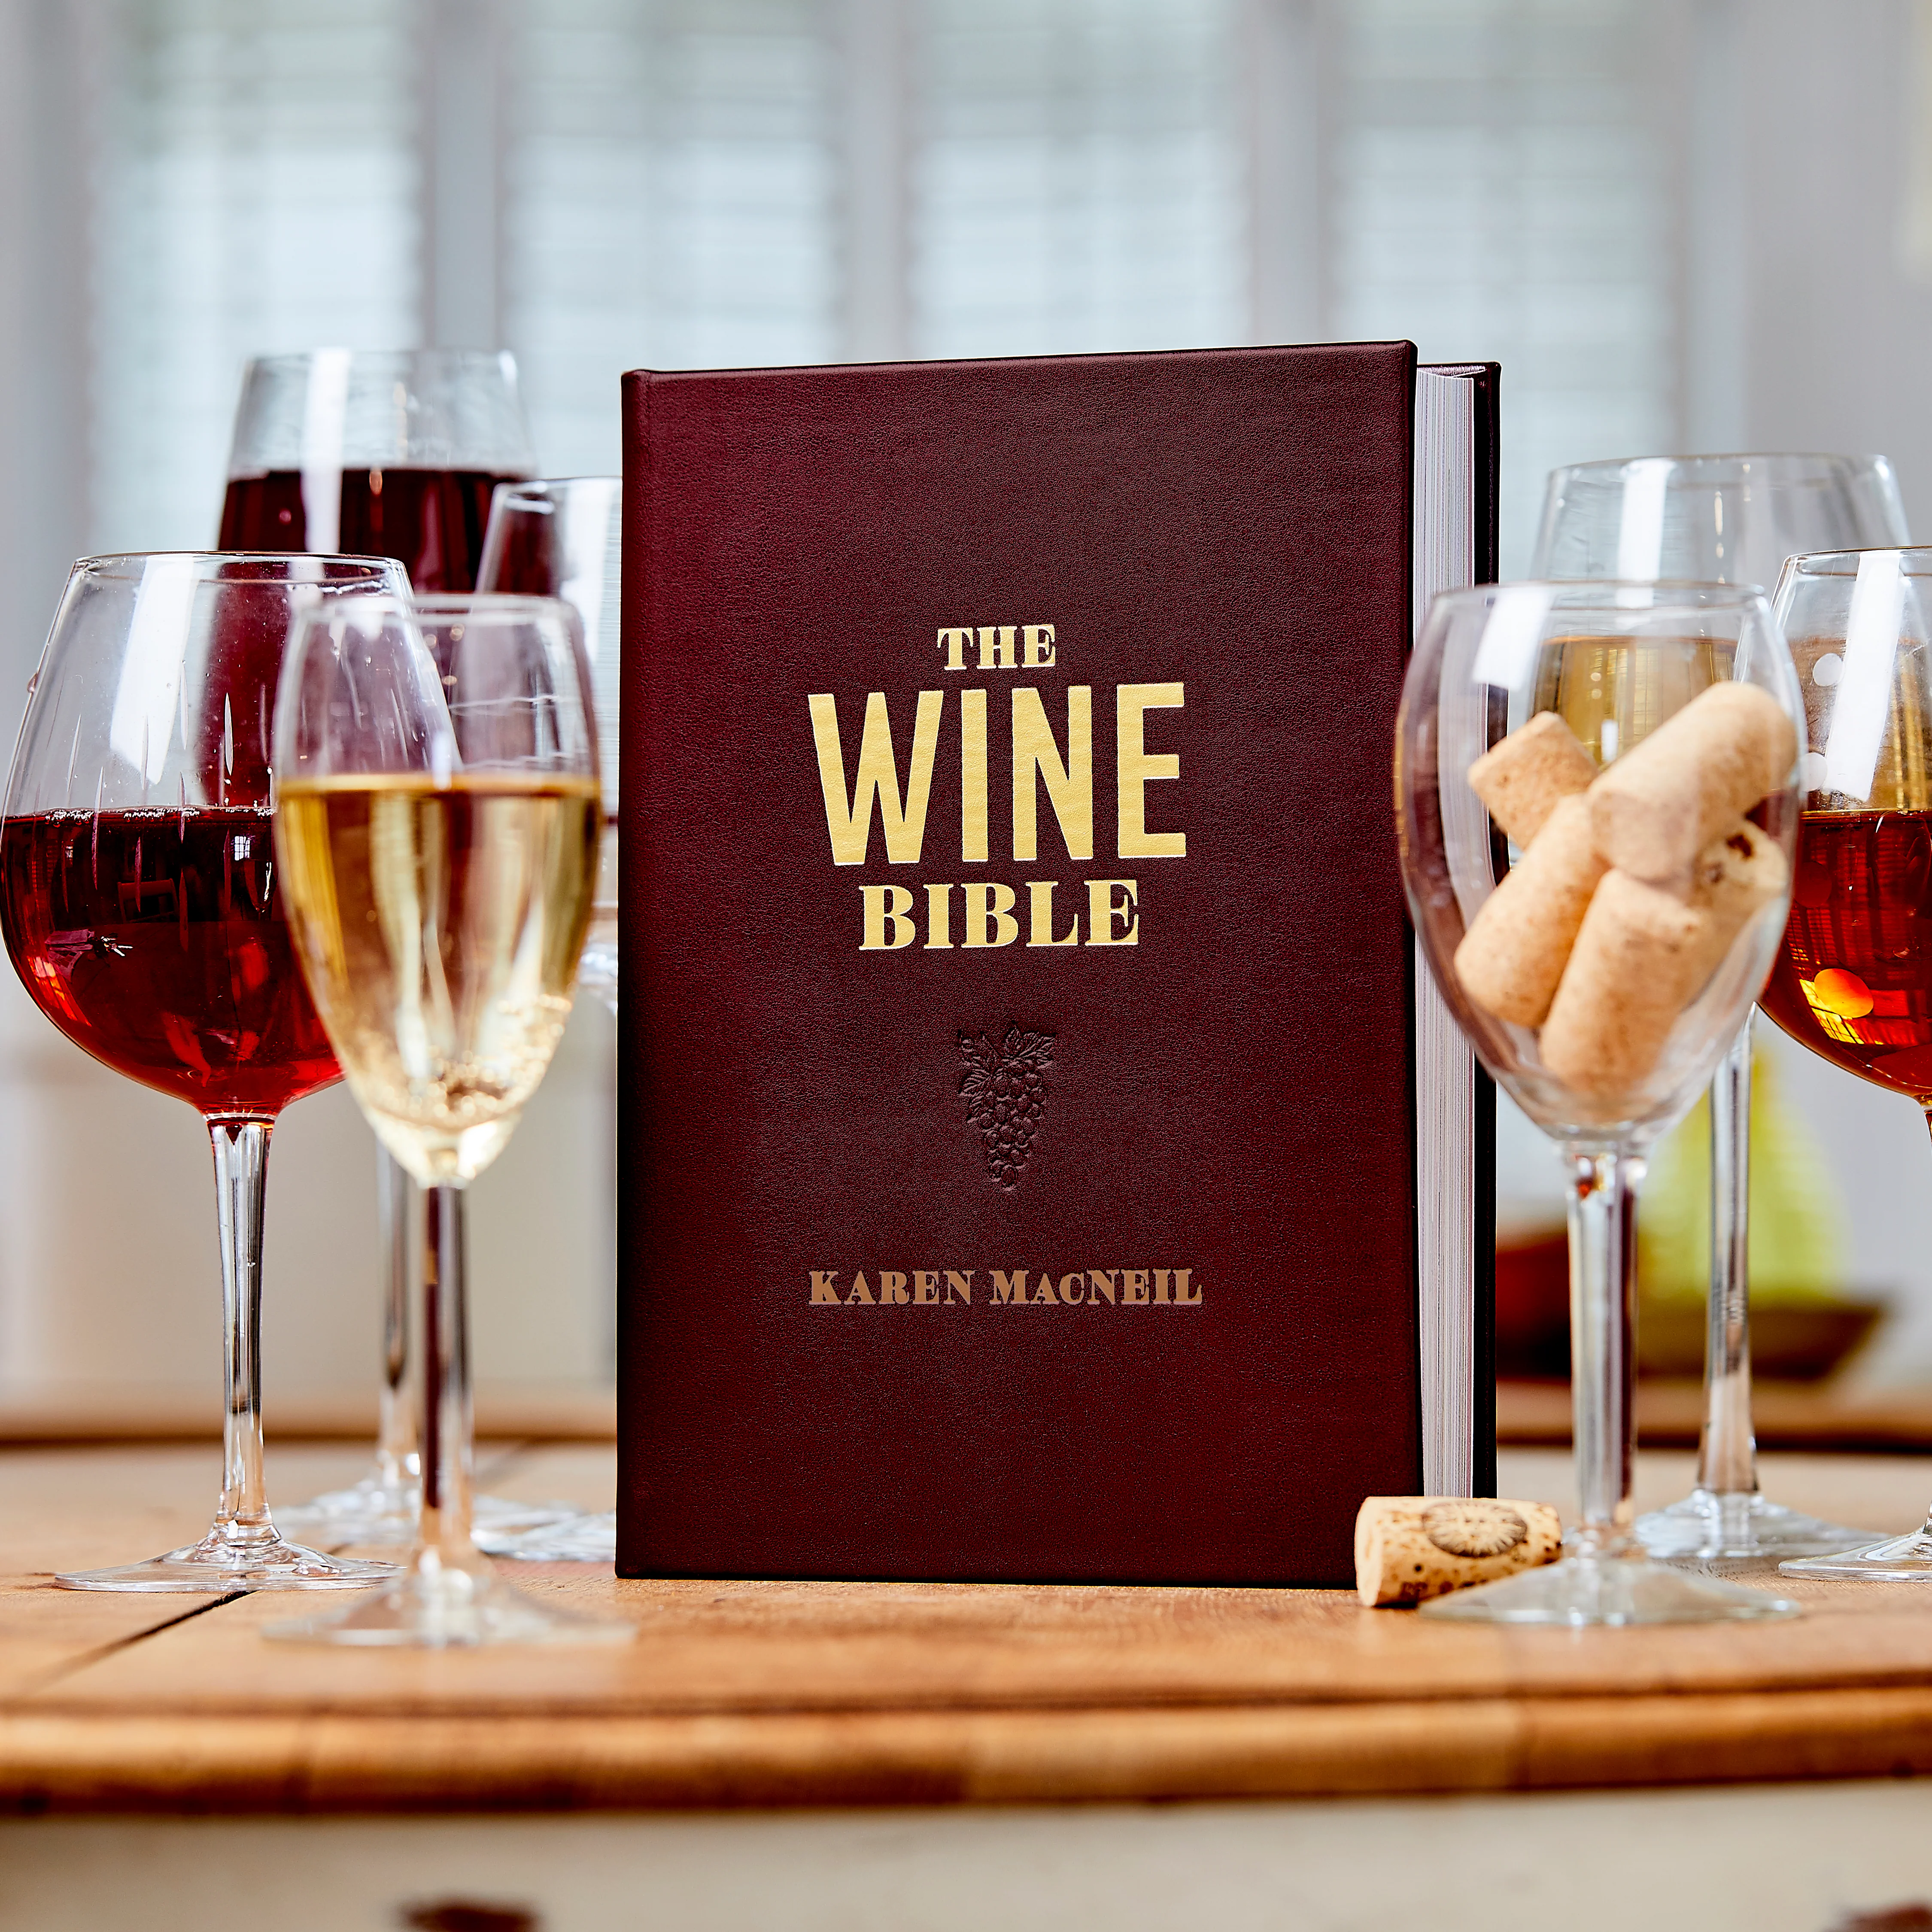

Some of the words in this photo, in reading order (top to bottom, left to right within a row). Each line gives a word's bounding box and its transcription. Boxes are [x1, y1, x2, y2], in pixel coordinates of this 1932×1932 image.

[936, 623, 1057, 672] THE
[807, 681, 1188, 867] WINE
[858, 878, 1140, 951] BIBLE
[808, 1269, 975, 1306] KAREN
